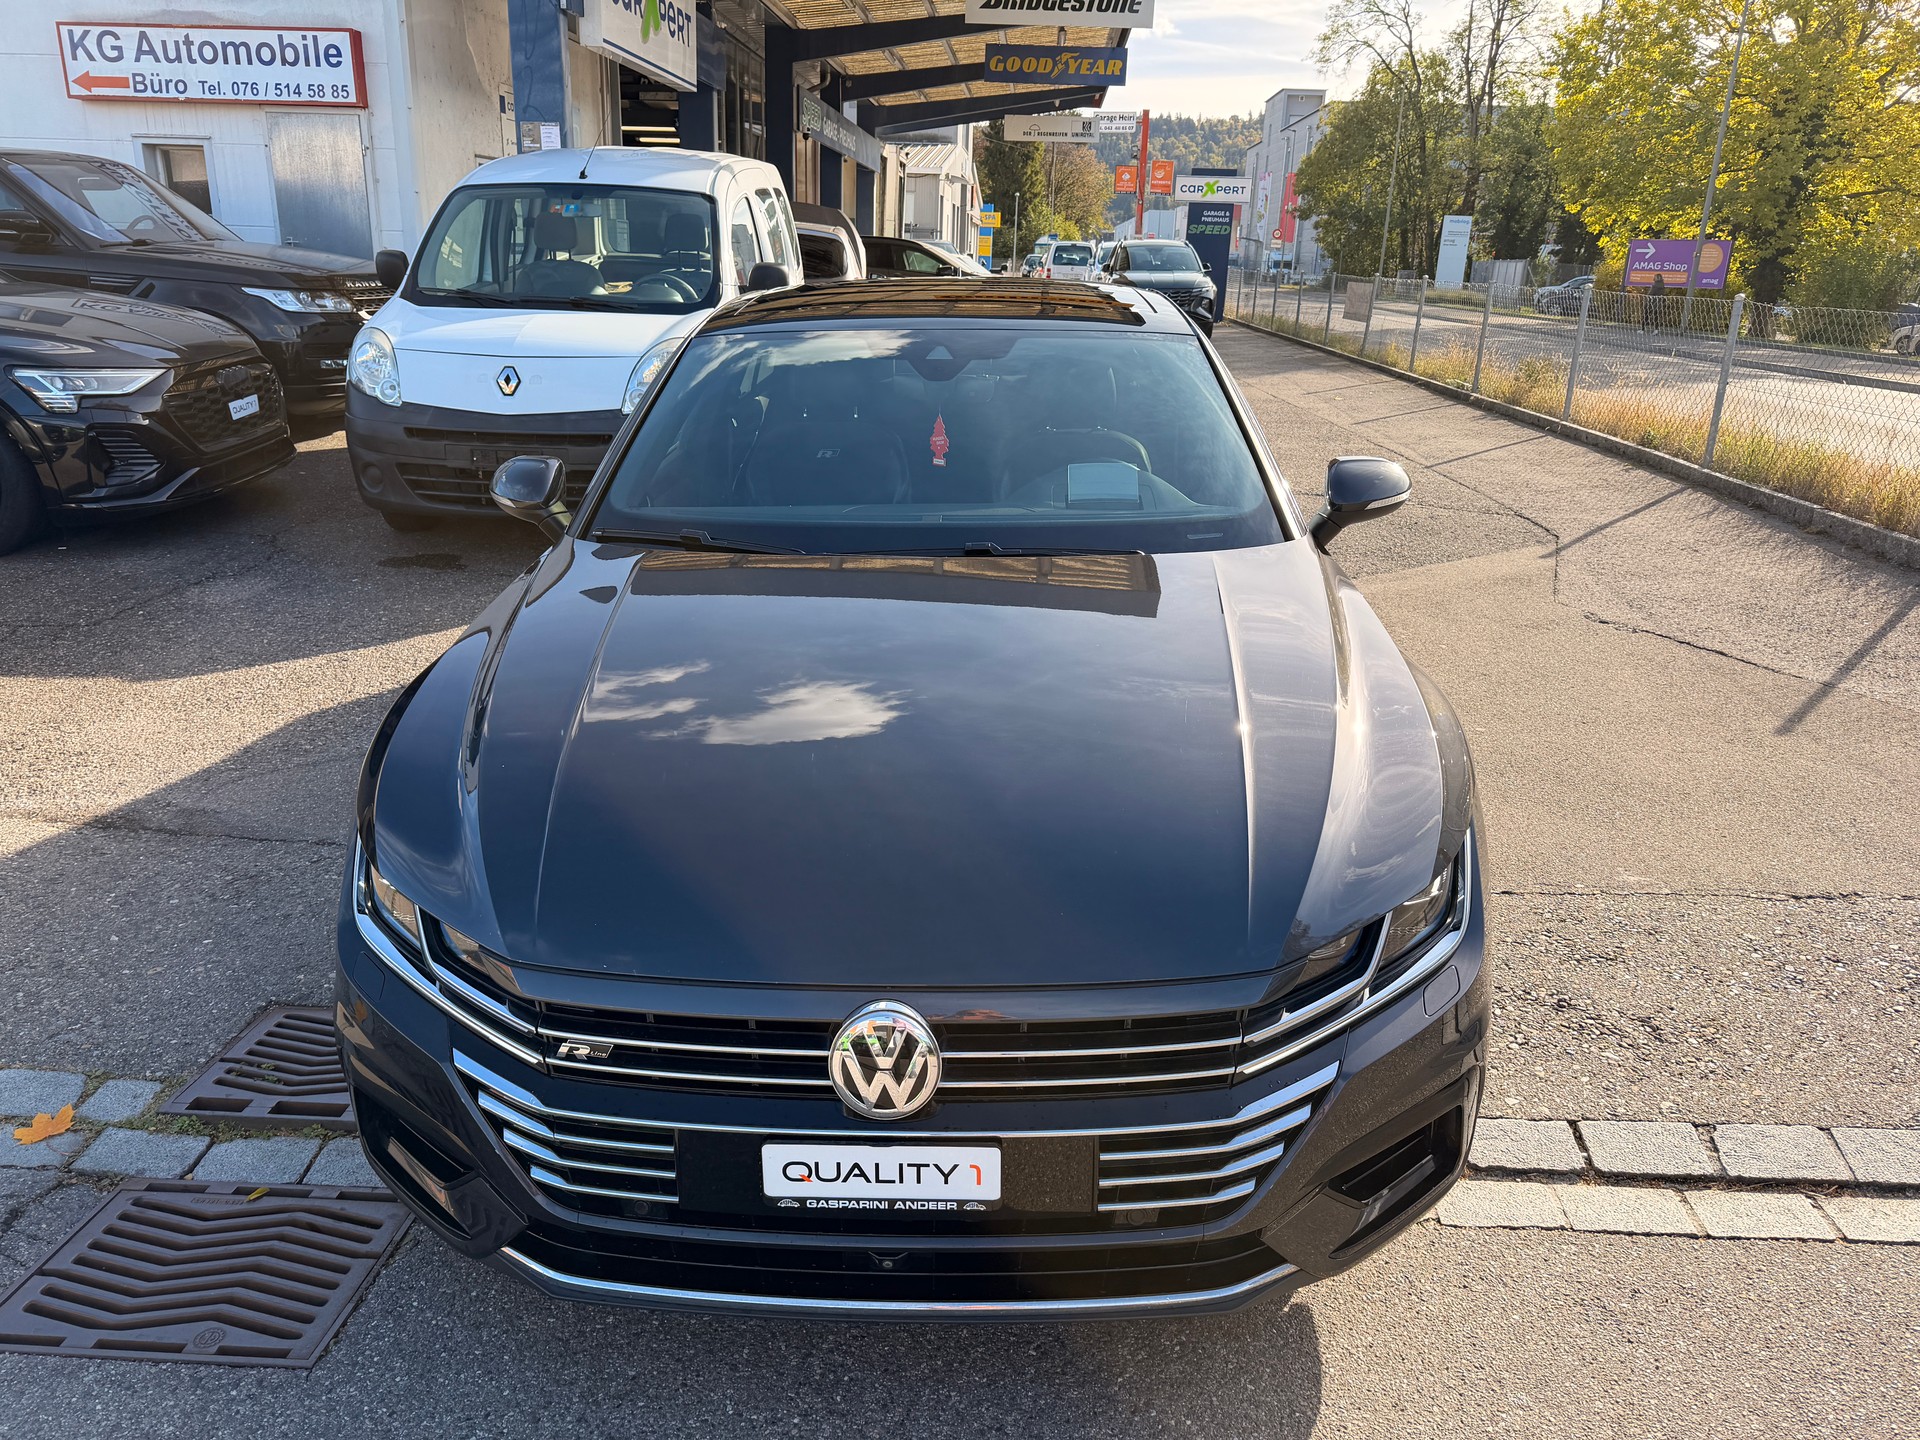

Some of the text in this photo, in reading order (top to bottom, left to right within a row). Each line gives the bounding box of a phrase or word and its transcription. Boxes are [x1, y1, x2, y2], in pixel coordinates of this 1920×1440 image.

[67, 29, 343, 68] KG Automobile
[131, 72, 188, 95] Büro
[198, 81, 226, 96] Tel.
[231, 81, 260, 97] 076
[274, 83, 302, 98] 514
[307, 84, 326, 99] 58
[331, 84, 350, 99] 85
[1188, 224, 1231, 235] SPEED
[1632, 261, 1688, 272] AMAG Shop
[232, 400, 254, 414] QUALITY
[781, 1161, 982, 1186] QUALITY 1
[806, 1199, 958, 1210] GASPARINI ANDEER
